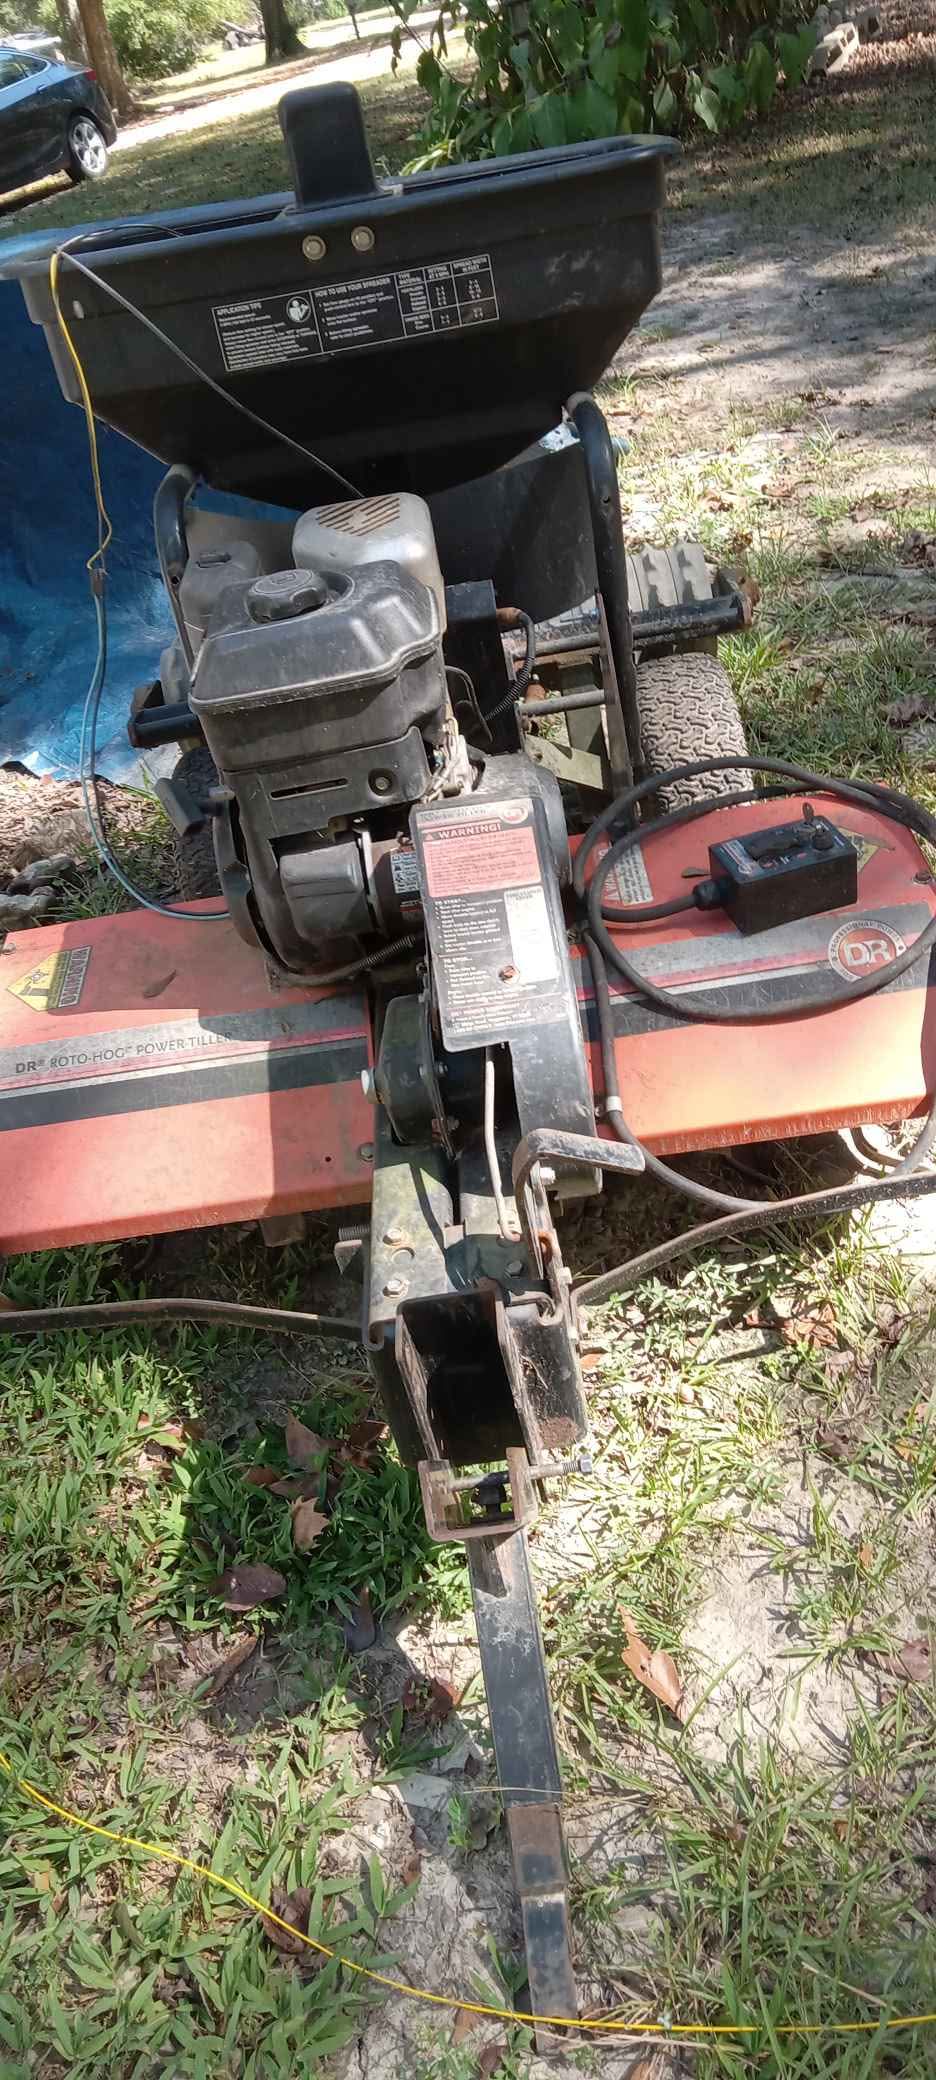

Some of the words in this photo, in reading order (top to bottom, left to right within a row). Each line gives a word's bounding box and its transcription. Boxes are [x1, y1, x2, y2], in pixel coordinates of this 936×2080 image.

[347, 282, 362, 292] YOUR
[362, 278, 391, 289] SPREADER
[217, 305, 250, 316] APPLICATION
[250, 302, 262, 310] TIPS
[438, 822, 501, 840] WARNING!
[843, 939, 893, 967] DR
[136, 1036, 185, 1056] POWER
[190, 1031, 233, 1047] TILLER
